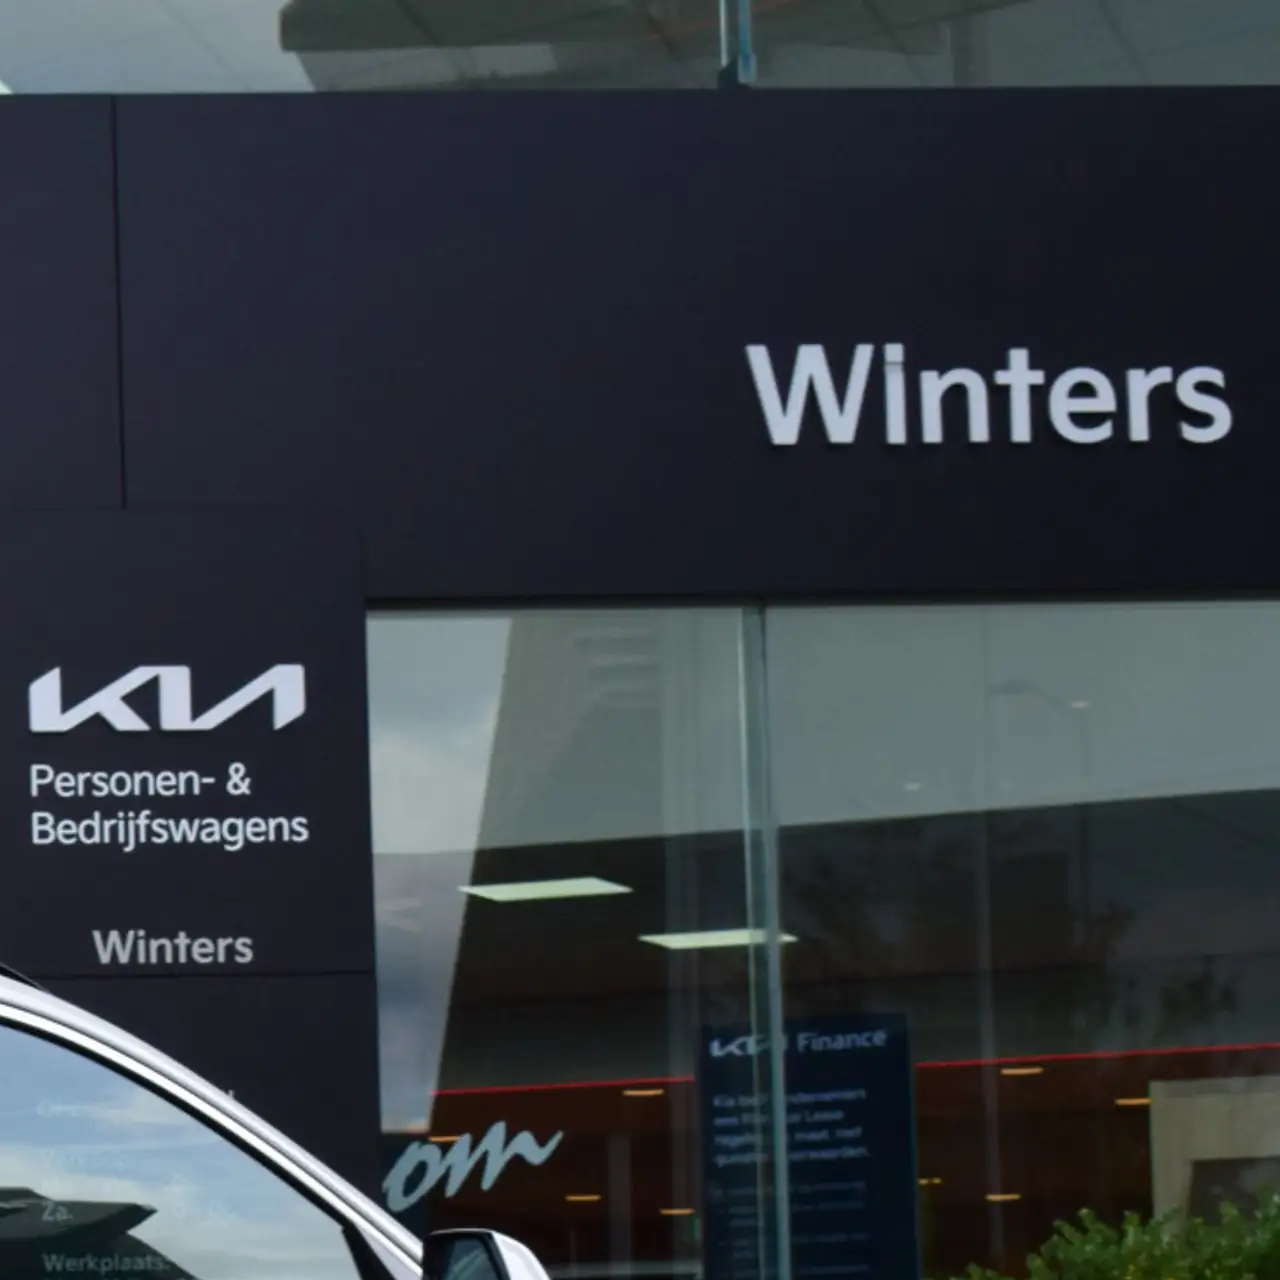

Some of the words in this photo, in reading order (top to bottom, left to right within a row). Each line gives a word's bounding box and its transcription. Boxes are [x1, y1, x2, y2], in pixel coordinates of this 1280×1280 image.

[745, 342, 1234, 446] Winters
[29, 664, 306, 732] KIA
[30, 764, 216, 797] Personen-
[226, 762, 252, 796] &
[31, 811, 309, 852] Bedrijfswagens
[92, 929, 254, 965] Winters
[797, 1029, 889, 1053] Finance
